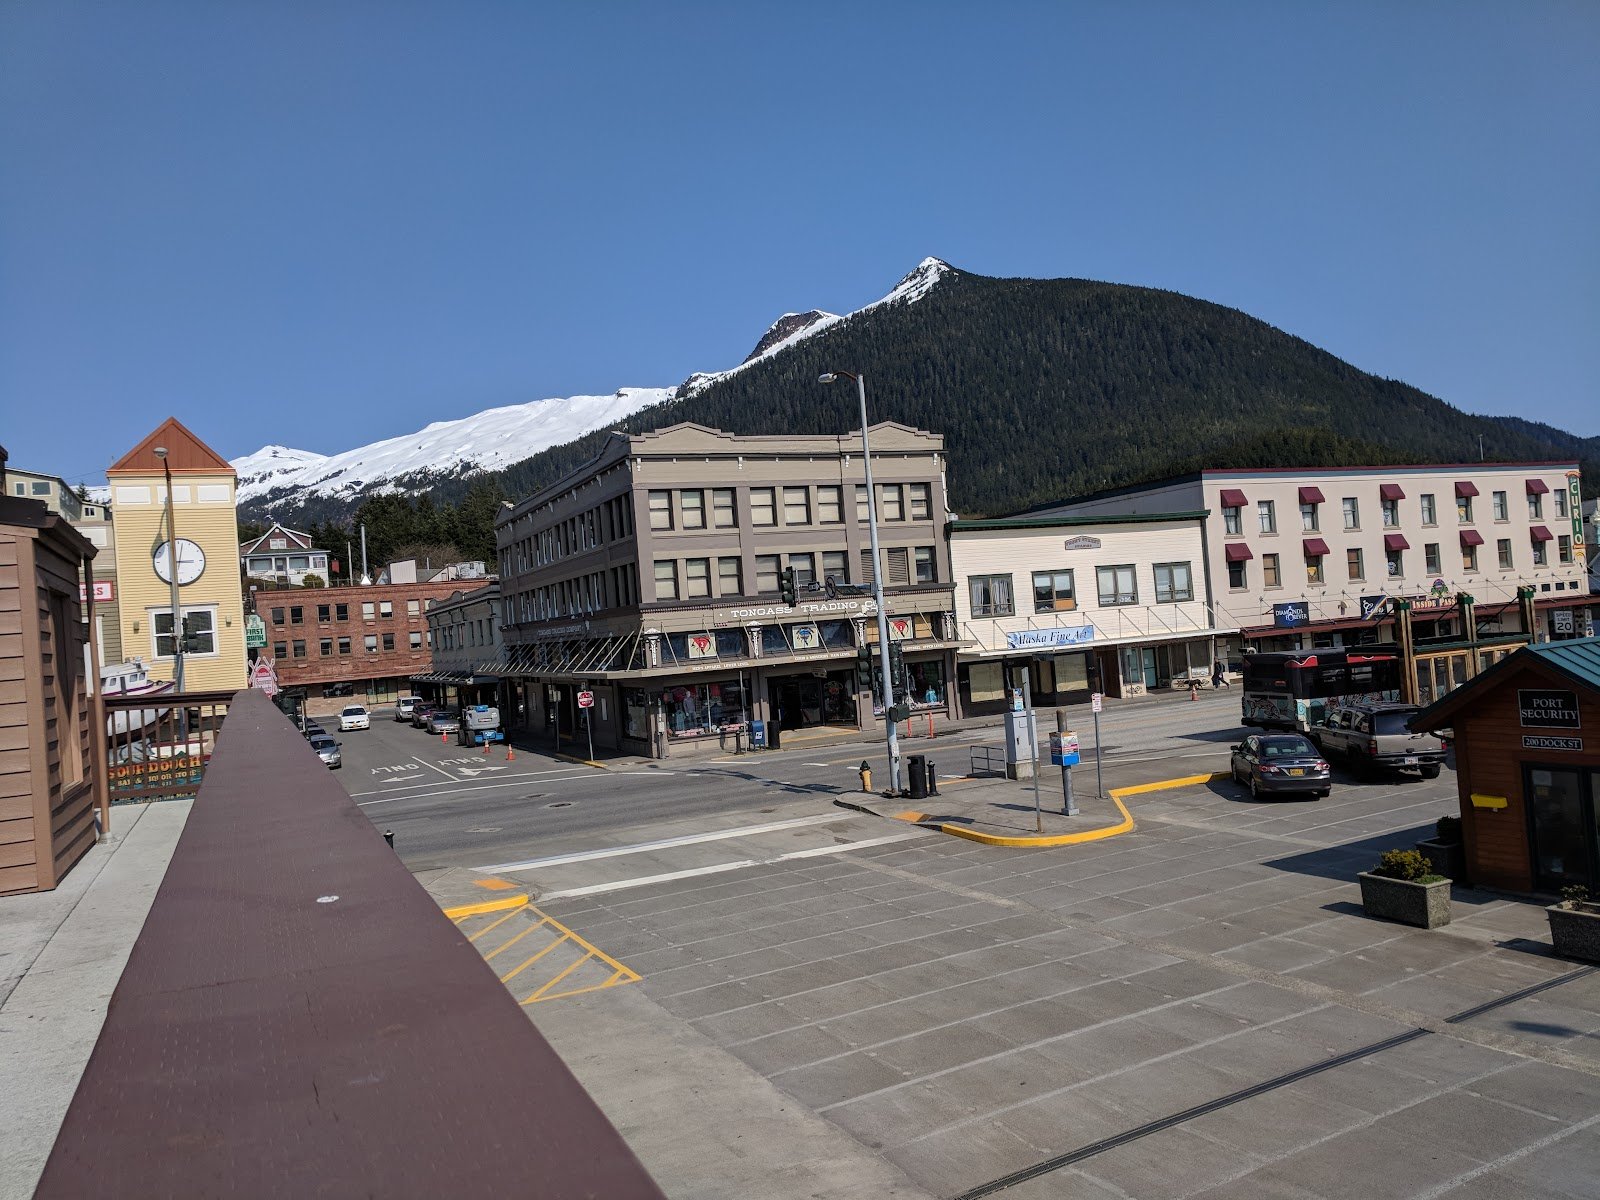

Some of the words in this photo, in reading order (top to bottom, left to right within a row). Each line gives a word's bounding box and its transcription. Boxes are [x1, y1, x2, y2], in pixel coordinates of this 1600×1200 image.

[1570, 483, 1583, 544] CURIO
[730, 606, 793, 618] TONGASS
[801, 601, 858, 613] TRADING
[1412, 600, 1437, 609] INSIDE
[1275, 608, 1303, 617] DIAMONDS
[246, 628, 263, 636] FIRST
[1557, 622, 1572, 631] 20
[1015, 633, 1047, 645] Alaska
[1050, 631, 1071, 642] Fine
[1072, 630, 1087, 640] Art
[1532, 698, 1564, 708] PORT
[1521, 708, 1577, 720] SECURITY
[1525, 737, 1539, 746] 200
[1540, 738, 1567, 748] DOCK
[1567, 740, 1580, 748] ST
[437, 756, 487, 766] ONLY
[371, 763, 420, 775] ONLY
[148, 774, 172, 782] IQOR
[175, 769, 197, 778] TOE
